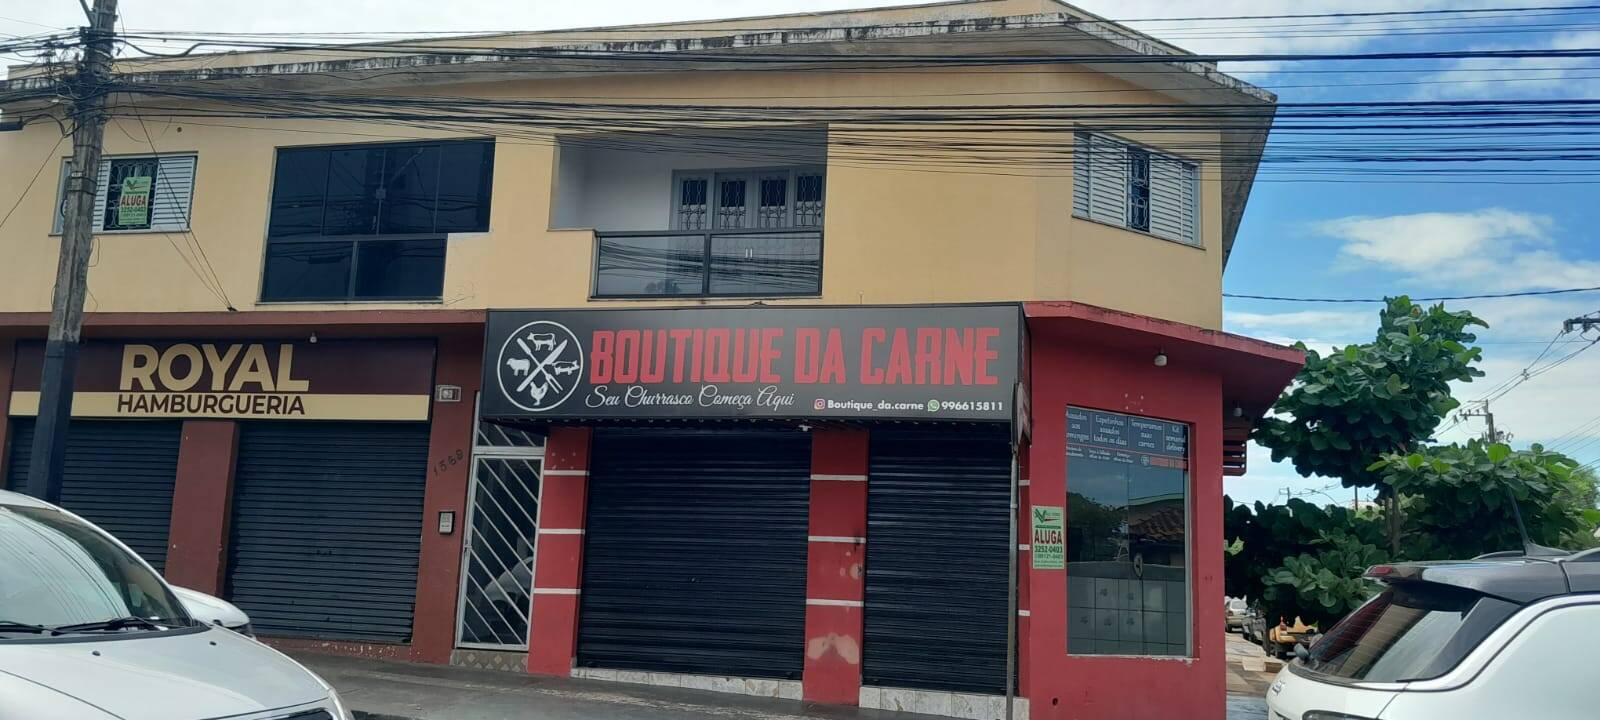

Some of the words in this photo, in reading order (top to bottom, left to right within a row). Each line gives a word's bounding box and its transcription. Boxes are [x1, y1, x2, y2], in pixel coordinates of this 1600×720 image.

[121, 195, 146, 206] ALUGA
[590, 329, 783, 385] BOUTIQUE
[794, 328, 847, 385] DA
[860, 327, 1000, 386] CARNE
[119, 343, 310, 392] ROYAL
[116, 393, 306, 415] HAMBURGUERIA
[585, 385, 620, 408] Seu
[624, 385, 693, 408] Churrasco
[699, 384, 752, 409] Começa
[756, 385, 795, 411] Aqui
[827, 399, 924, 412] Boutique_da.carne
[941, 401, 1003, 411] 996615811
[1093, 434, 1109, 443] todos
[1034, 530, 1062, 544] ALUGA
